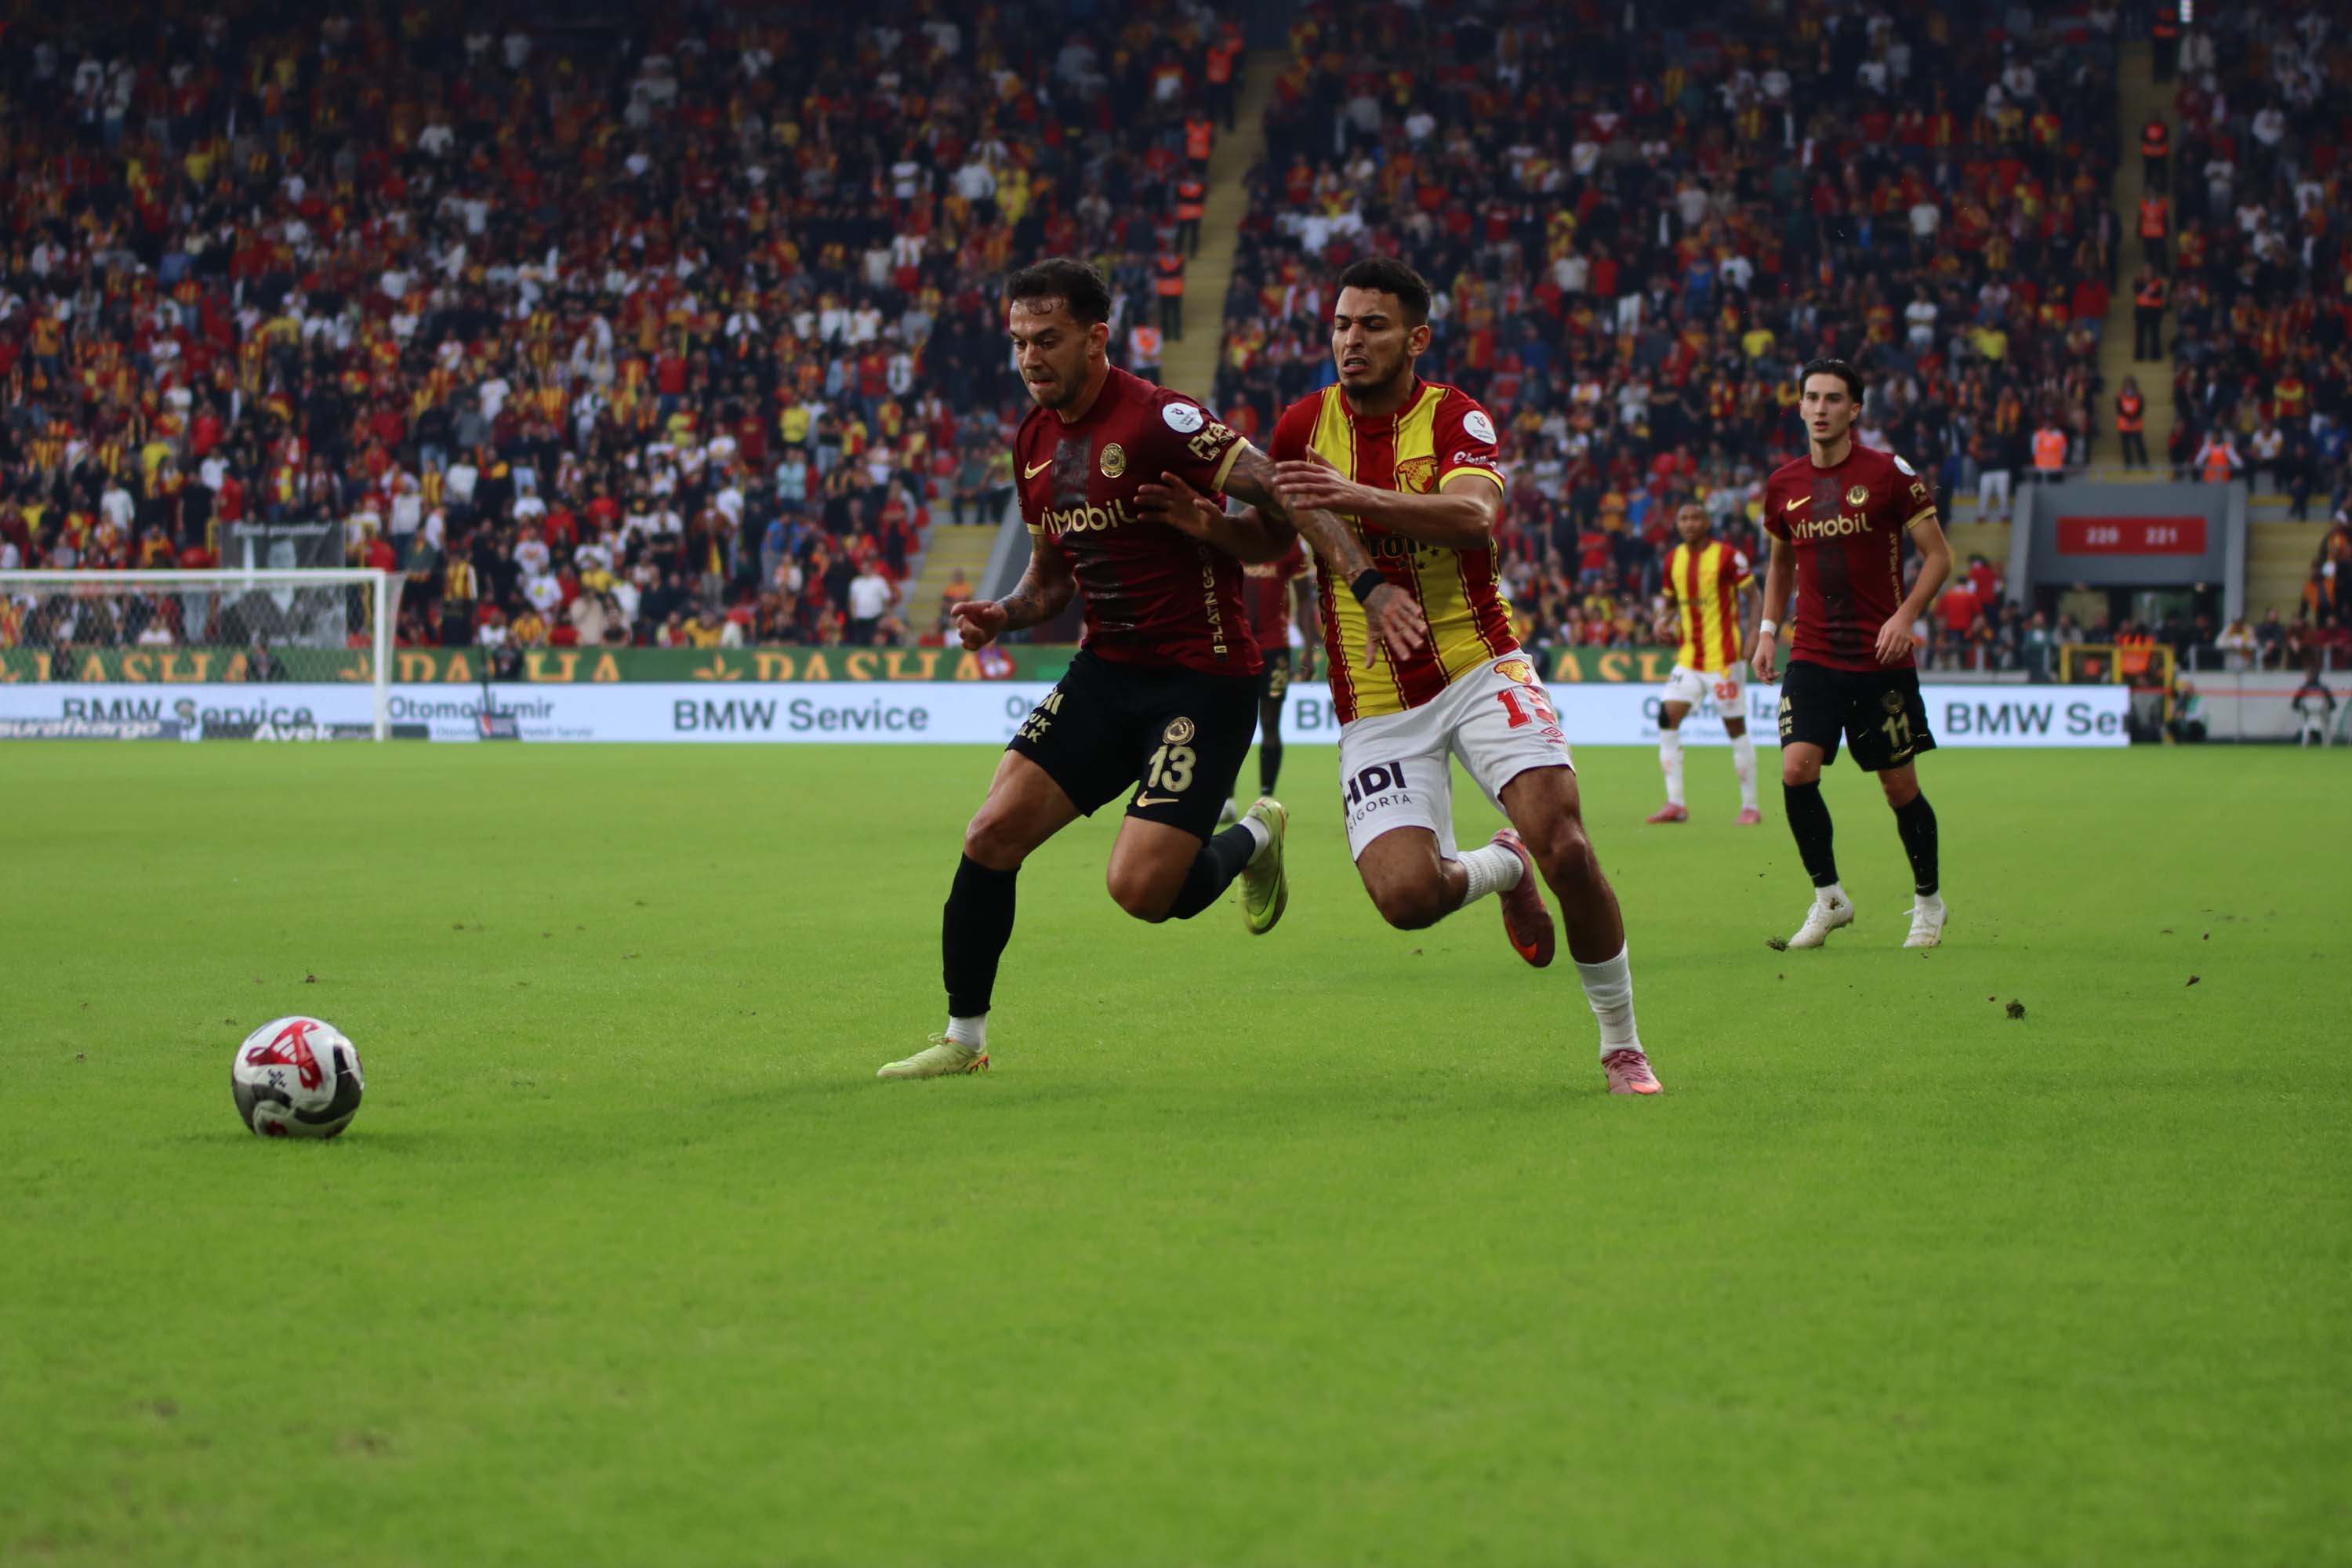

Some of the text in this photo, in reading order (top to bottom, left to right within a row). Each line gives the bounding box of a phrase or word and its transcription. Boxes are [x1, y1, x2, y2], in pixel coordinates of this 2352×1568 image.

[34, 652, 246, 681] ASHA
[673, 699, 929, 731] BMW Service
[1946, 702, 2053, 735] BMW
[1148, 745, 1196, 793] 13
